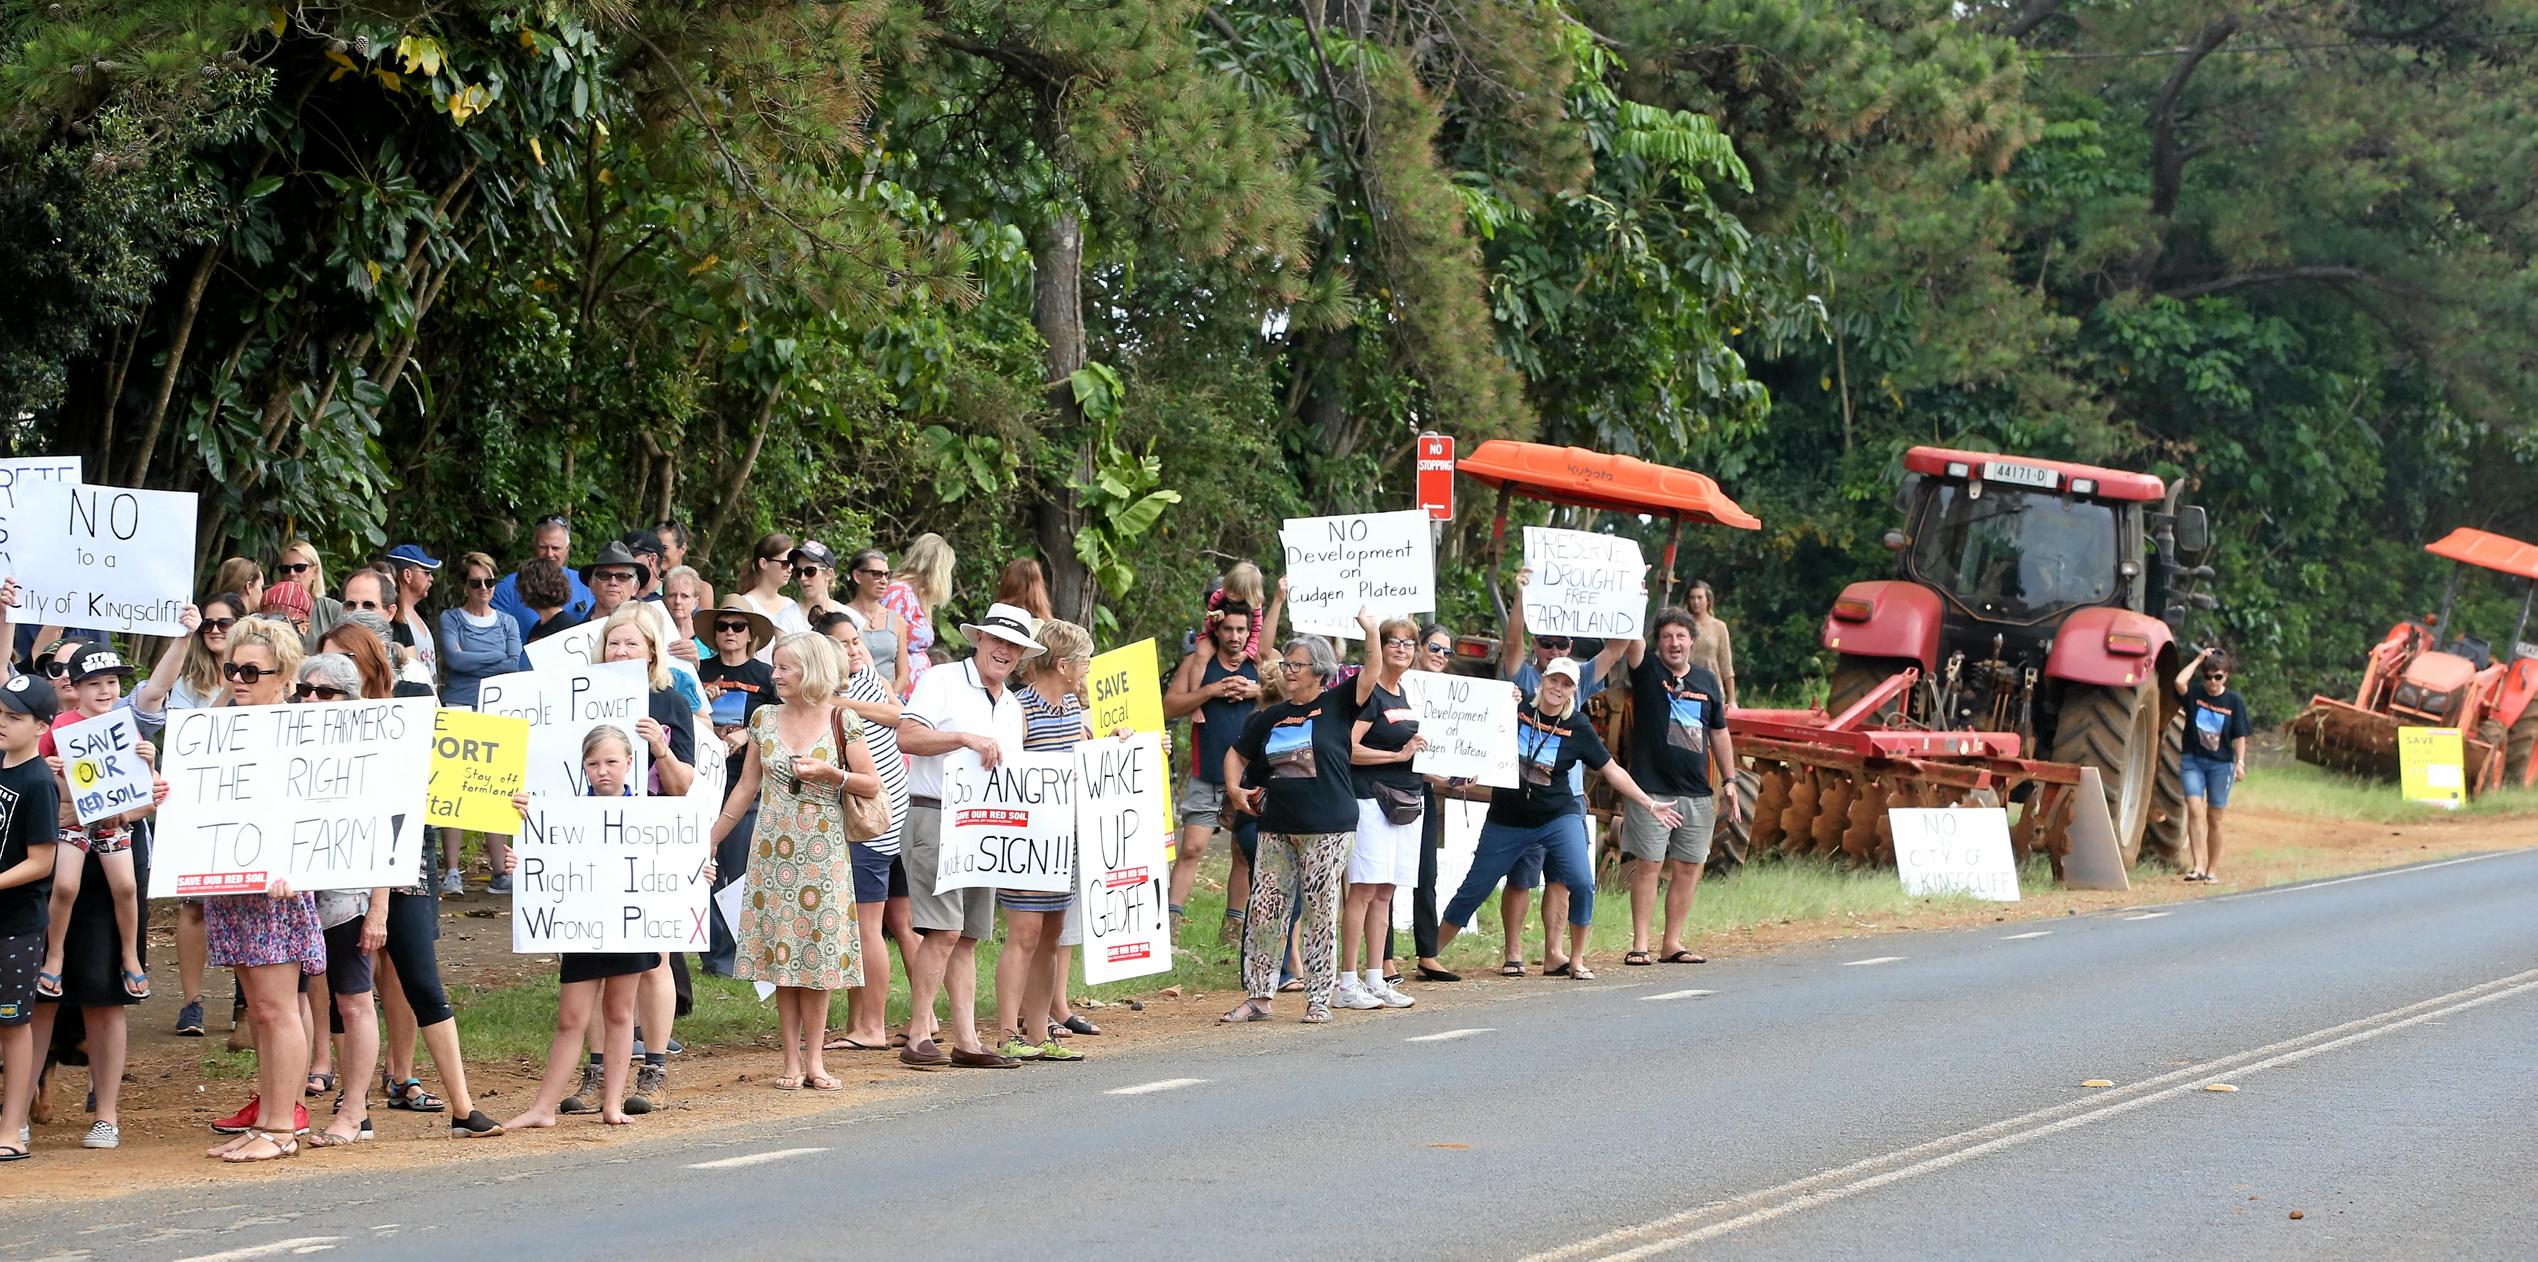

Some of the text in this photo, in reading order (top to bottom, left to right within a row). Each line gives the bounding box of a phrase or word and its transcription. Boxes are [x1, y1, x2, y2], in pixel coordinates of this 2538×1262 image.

[1429, 443, 1443, 455] NO
[1418, 459, 1452, 471] STOPPING
[1567, 463, 1614, 482] Kubota
[69, 488, 139, 540] NO
[1327, 519, 1368, 543] NO
[1531, 528, 1626, 563] PRESERVE
[77, 546, 116, 568] to a
[1287, 539, 1413, 567] Development
[1339, 567, 1361, 580] on
[1543, 561, 1631, 592] DROUGHT
[55, 591, 78, 614] of
[1288, 580, 1418, 608] Cudgen Plateau
[1564, 588, 1601, 605] FREE
[1526, 604, 1635, 635] FARMLAND
[1095, 670, 1130, 702] SAVE
[1447, 680, 1469, 703] NO
[1100, 698, 1130, 729] local
[1423, 700, 1489, 726] Development
[69, 721, 130, 759] SAVE
[175, 704, 406, 756] GIVE THE FARMERS
[1445, 727, 1459, 737] on
[1422, 738, 1487, 760] dgen Plateau
[78, 754, 126, 784] OUR
[186, 752, 379, 804] THE RIGHT
[464, 767, 519, 786] Stay off
[1082, 746, 1144, 800] WAKE
[954, 767, 972, 804] So
[983, 766, 1073, 805] ANGRY
[77, 782, 148, 819] RED SOIL
[971, 810, 988, 819] OUR
[989, 811, 1007, 820] RED
[1008, 811, 1028, 821] SOIL
[1922, 812, 1957, 836] NO
[603, 809, 699, 855] Hospital
[1099, 808, 1140, 870] UP
[197, 822, 263, 873] TO
[964, 853, 975, 873] a
[977, 835, 1069, 875] SIGN!!
[1965, 848, 1984, 866] OF
[178, 872, 266, 887] SAVE OUR RED SOIL
[524, 856, 678, 904] Right Idea
[521, 906, 604, 950] Wrong
[623, 905, 684, 940] Place
